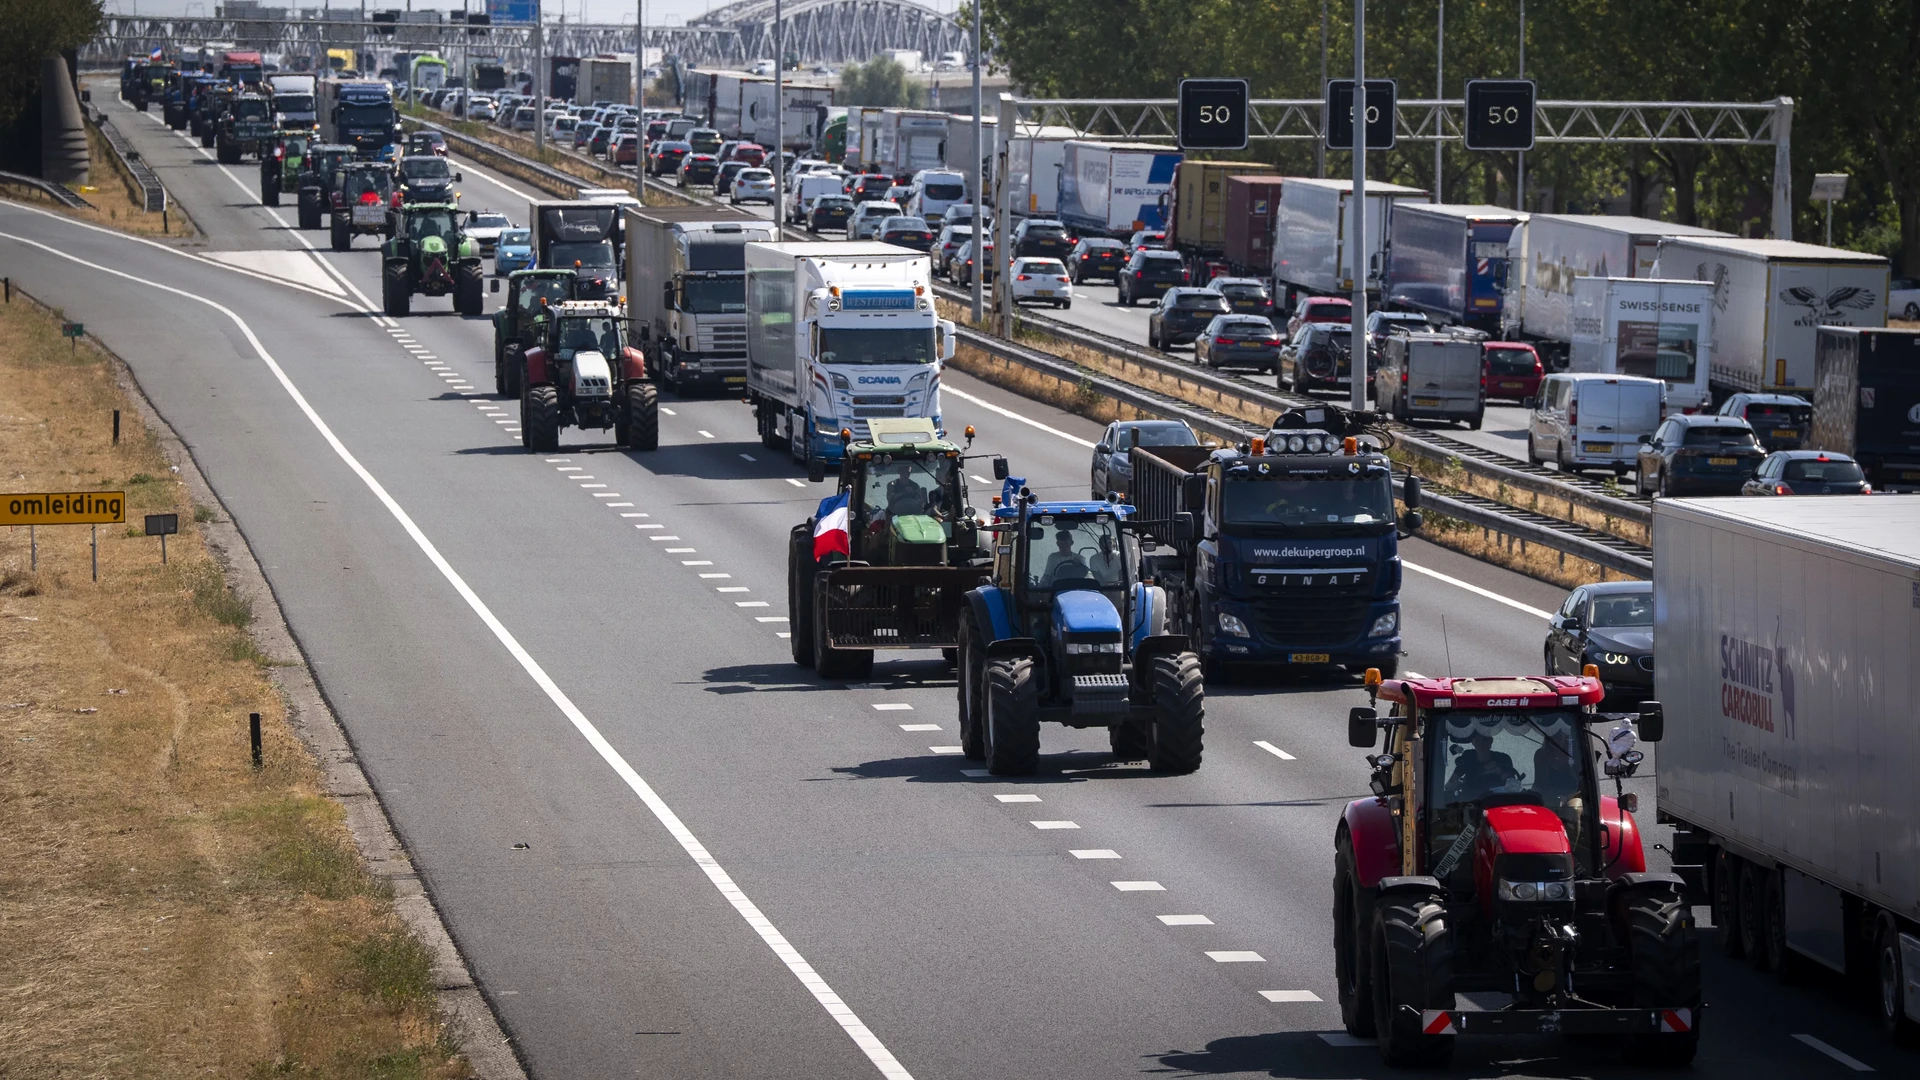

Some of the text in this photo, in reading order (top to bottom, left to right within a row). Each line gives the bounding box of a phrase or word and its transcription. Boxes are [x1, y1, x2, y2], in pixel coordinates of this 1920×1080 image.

[1200, 105, 1230, 123] 50
[1488, 106, 1519, 124] 50
[846, 296, 911, 306] WESTERHOUT
[857, 376, 901, 384] SCANIA
[9, 494, 121, 520] omleiding
[1253, 546, 1365, 558] www.dekuipergroep.nl
[1257, 574, 1361, 585] GINAF
[1721, 634, 1774, 694] SCHMITZ
[1487, 698, 1517, 706] CASE
[1721, 682, 1774, 733] CARGOBULL
[1722, 736, 1797, 788] The Trailer Company
[1436, 828, 1475, 877] PROUD FARMER
